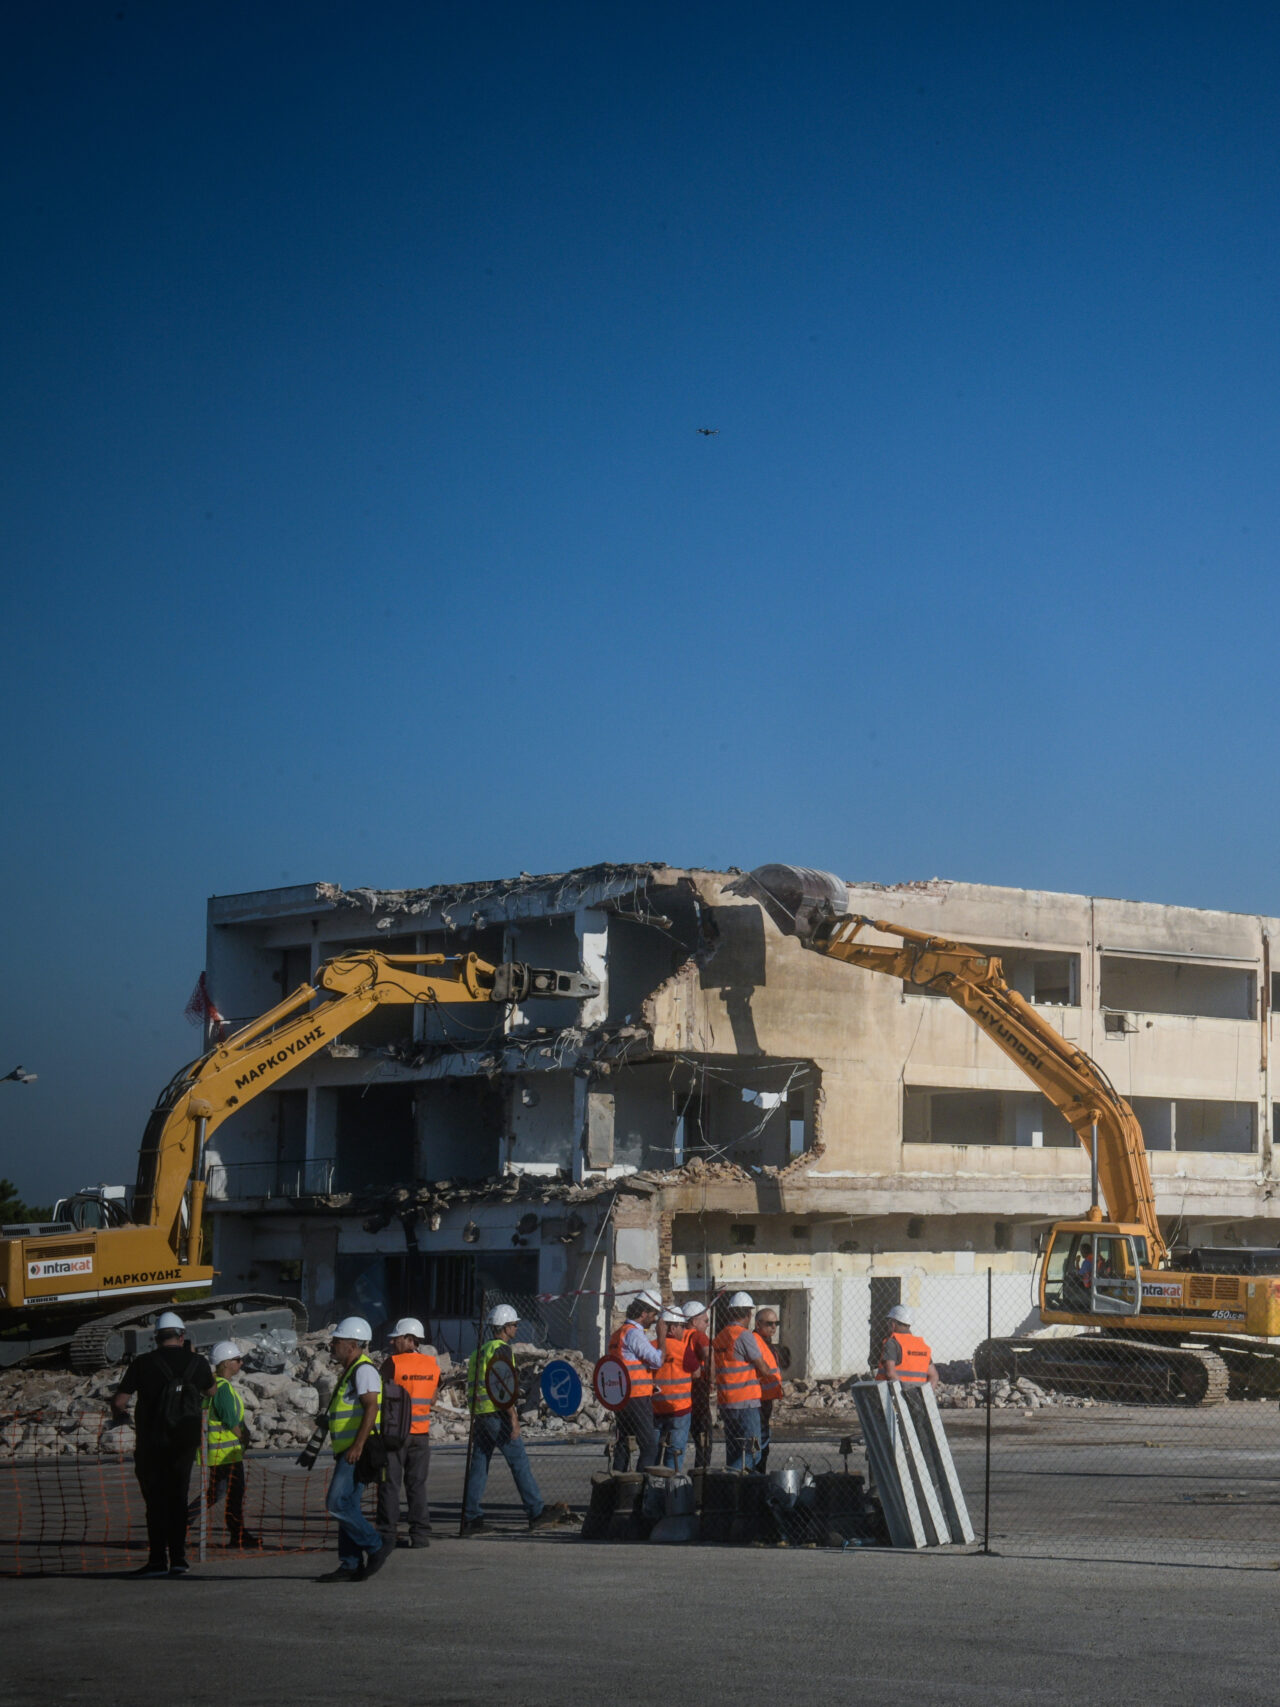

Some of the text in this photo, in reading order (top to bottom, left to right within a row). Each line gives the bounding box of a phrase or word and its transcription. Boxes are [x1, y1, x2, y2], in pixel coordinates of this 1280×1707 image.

[976, 1006, 1043, 1070] HYUNDAI
[235, 1025, 326, 1090] ΜΑΡΚΟΥΔΗΣ
[44, 1259, 91, 1275] intrakat
[103, 1268, 182, 1286] ΜΑΡΚΟΥΔΗΣ
[1141, 1284, 1182, 1297] ntrakat
